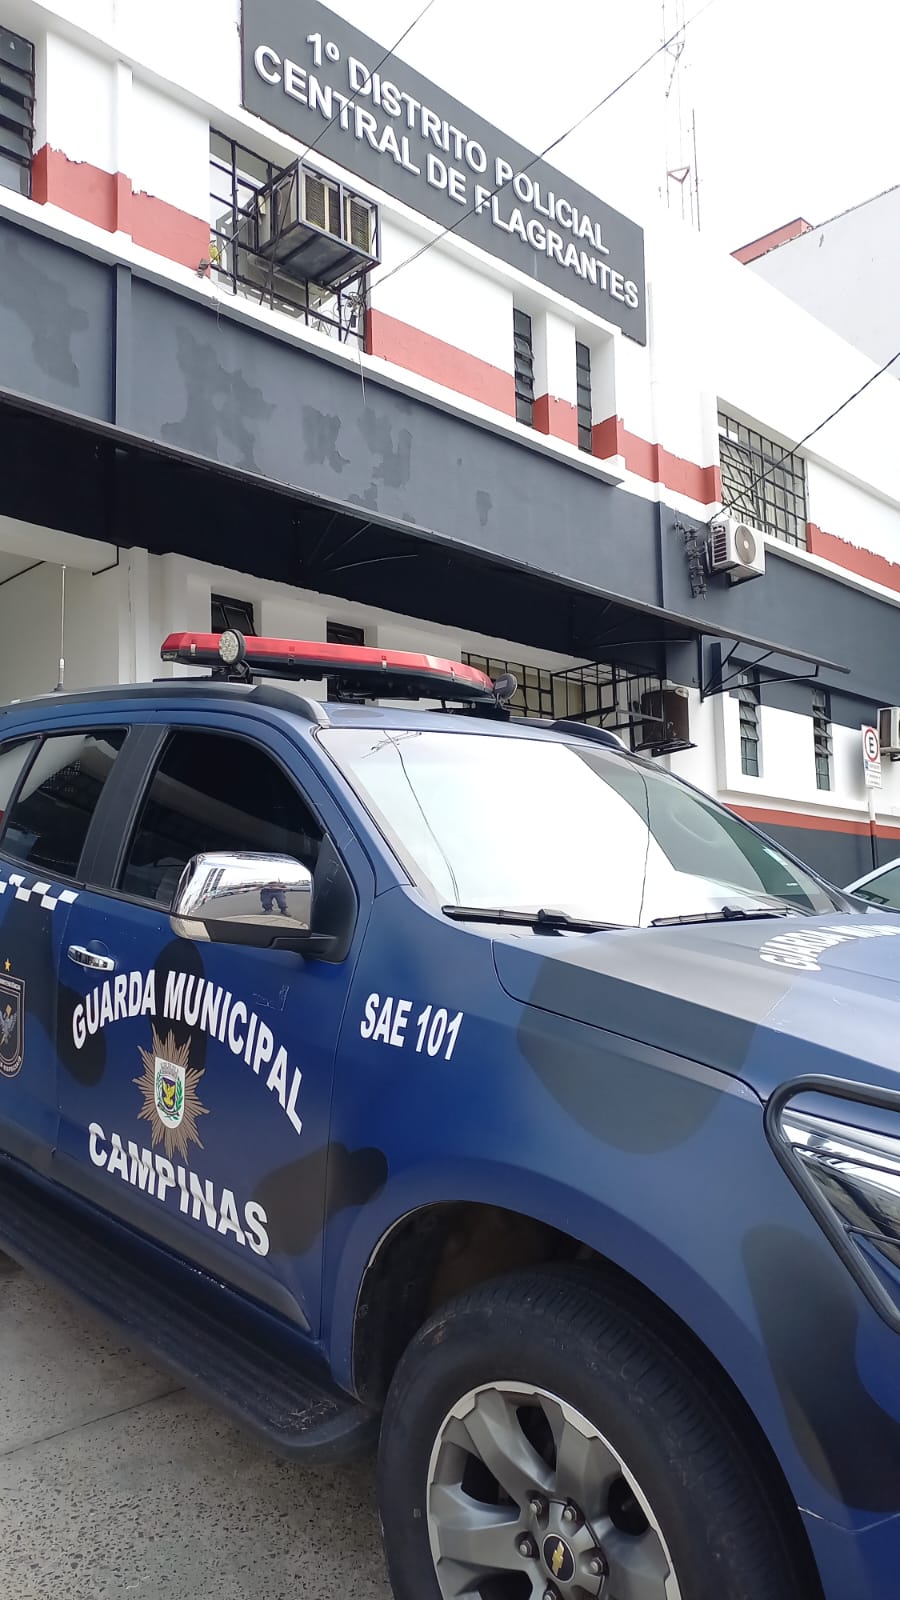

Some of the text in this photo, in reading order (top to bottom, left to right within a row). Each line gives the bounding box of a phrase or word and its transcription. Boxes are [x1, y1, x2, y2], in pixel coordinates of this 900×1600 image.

[253, 45, 639, 309] CENTRAL DE FLAGRANTES
[348, 56, 488, 174] DISTRITO
[495, 156, 610, 255] POLICIAL
[868, 736, 875, 754] E
[72, 969, 303, 1136] GUARDA MUNICIPAL
[360, 992, 464, 1061] SAE 101
[88, 1122, 271, 1257] CAMPINAS
